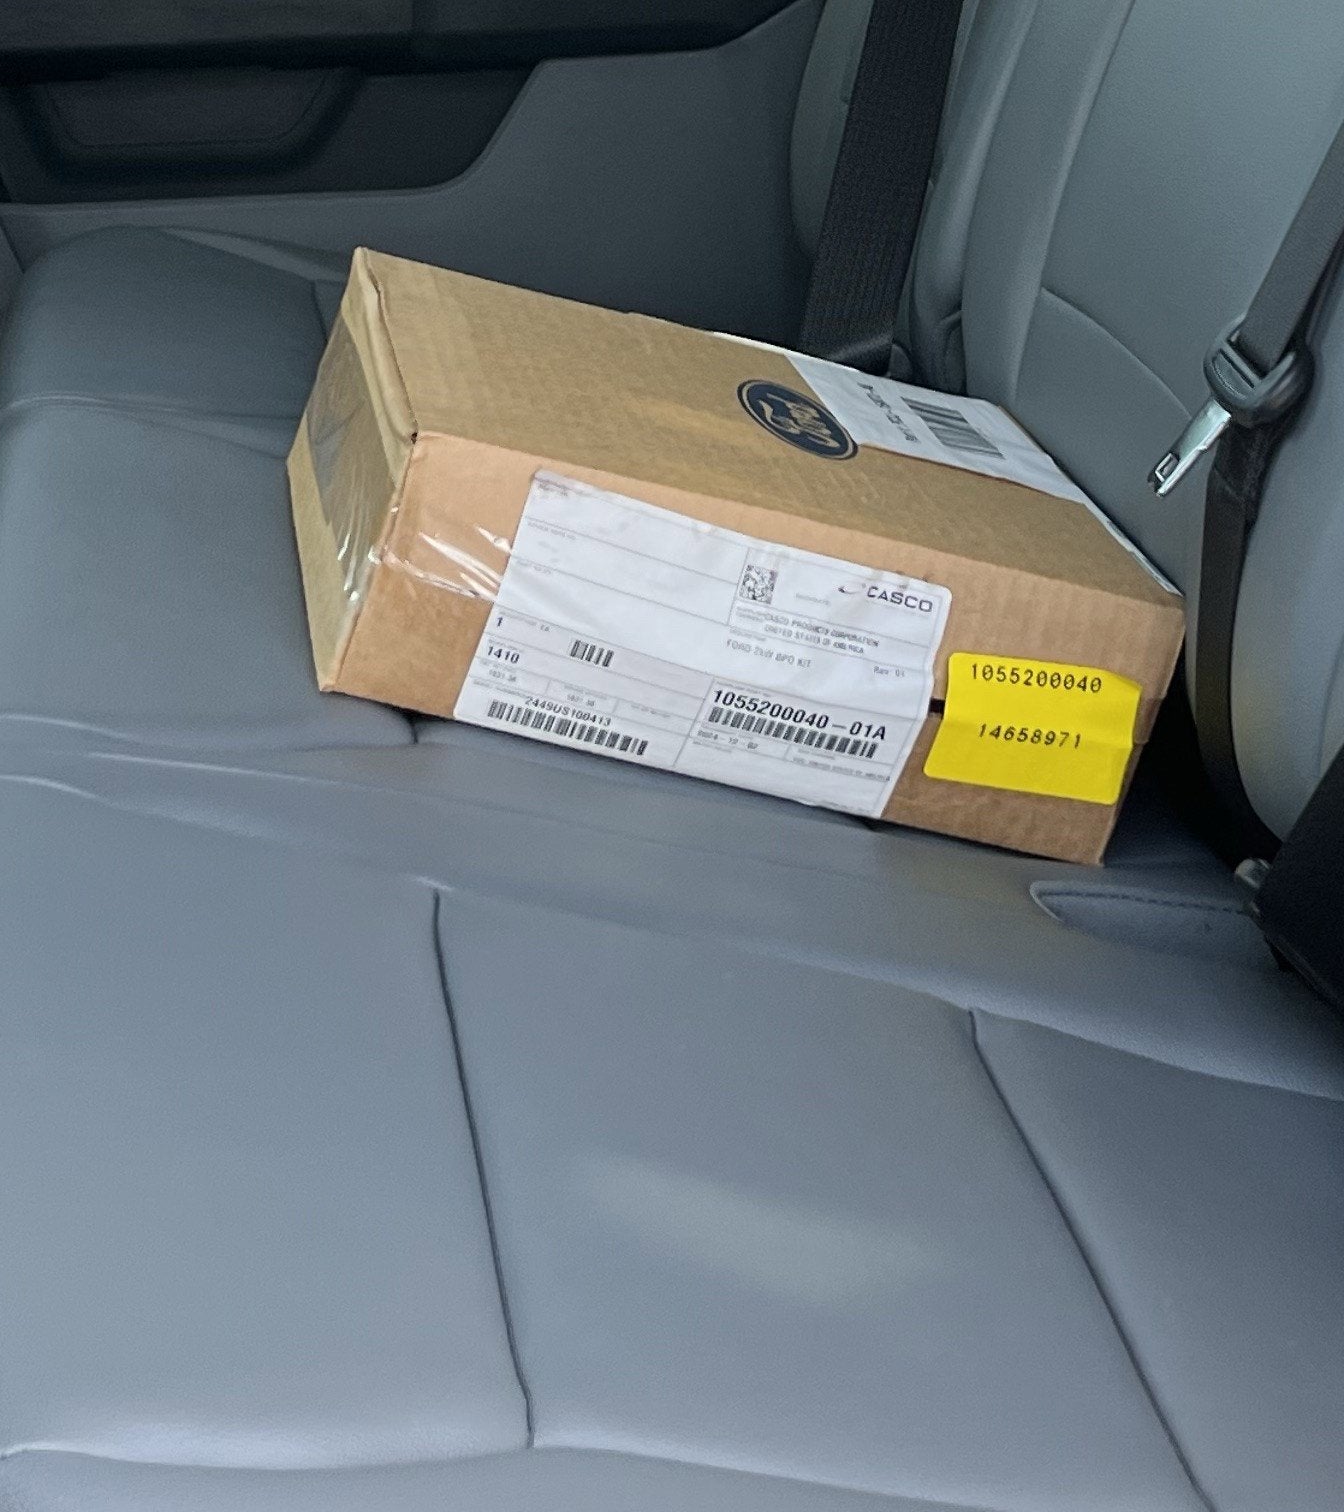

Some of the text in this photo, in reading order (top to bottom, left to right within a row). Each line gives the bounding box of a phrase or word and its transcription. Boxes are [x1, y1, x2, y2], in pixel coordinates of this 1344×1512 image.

[866, 585, 933, 613] CASCO
[497, 616, 504, 627] 1
[487, 645, 521, 665] 1410
[971, 662, 1103, 694] 1055200040
[978, 722, 1082, 750] 14658971
